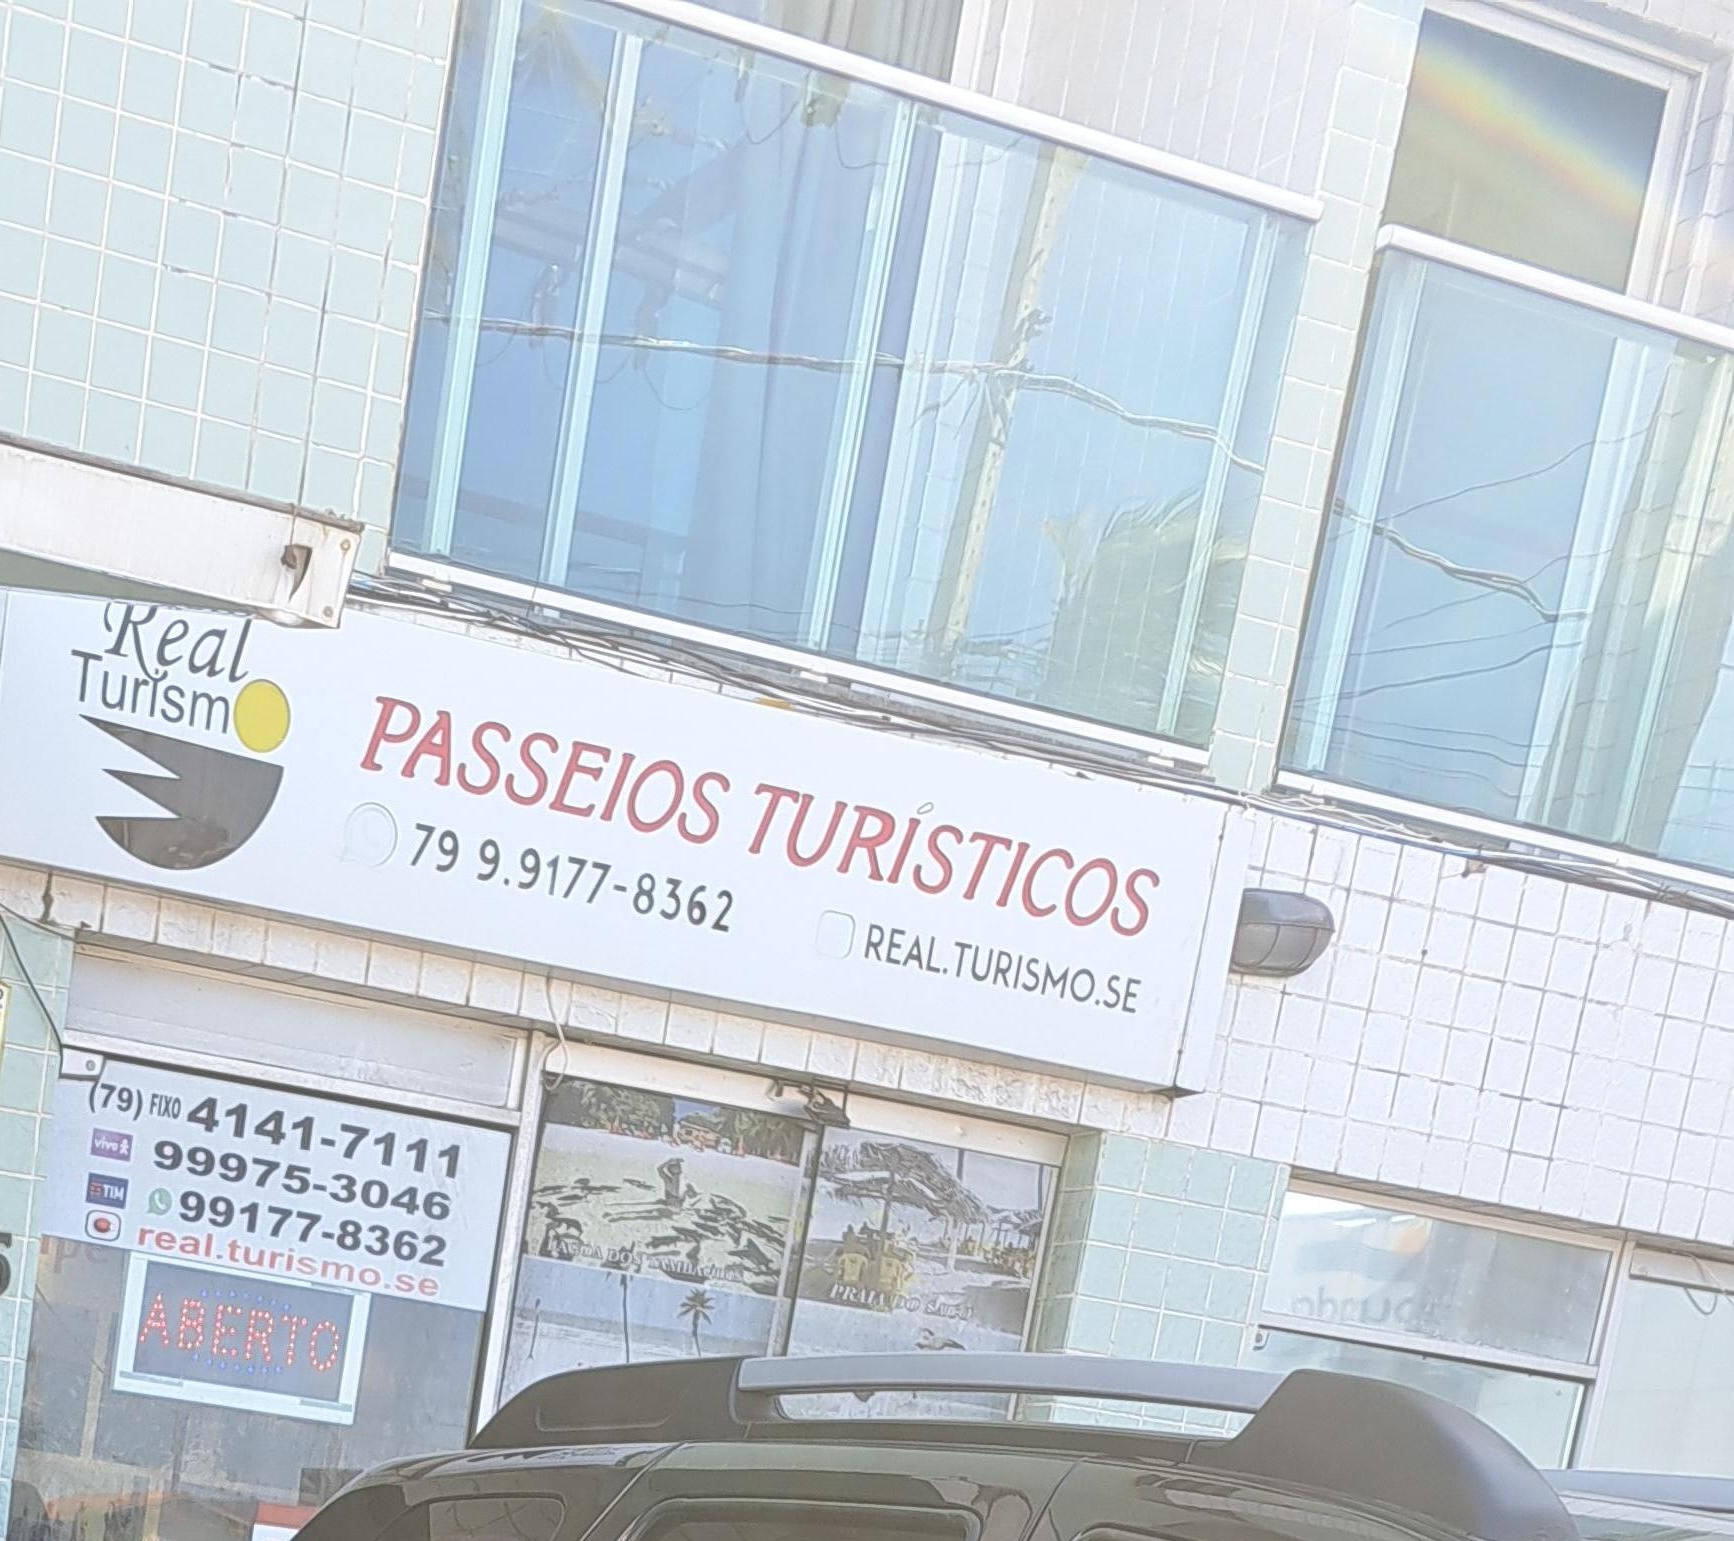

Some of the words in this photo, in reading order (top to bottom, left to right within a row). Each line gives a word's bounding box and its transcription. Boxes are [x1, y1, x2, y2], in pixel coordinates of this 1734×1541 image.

[104, 602, 252, 682] Real
[360, 696, 731, 844] PASSEIOS
[748, 782, 1160, 937] TURÍSTICOS
[410, 822, 459, 872] 79
[476, 838, 733, 933] 9.9177-8362
[864, 923, 1142, 1014] REAL.TURISMO.SE
[88, 1081, 143, 1120] (79)
[149, 1093, 181, 1120] FIXO
[187, 1096, 461, 1179] 4141-7111
[94, 1136, 118, 1152] vivo
[103, 1184, 125, 1201] TIM
[153, 1140, 451, 1220] 99975-3046
[138, 1224, 438, 1297] real.turismo.se
[179, 1190, 447, 1266] 99177-8362
[139, 1293, 339, 1371] ABERTO
[829, 1283, 886, 1306] PRAIA
